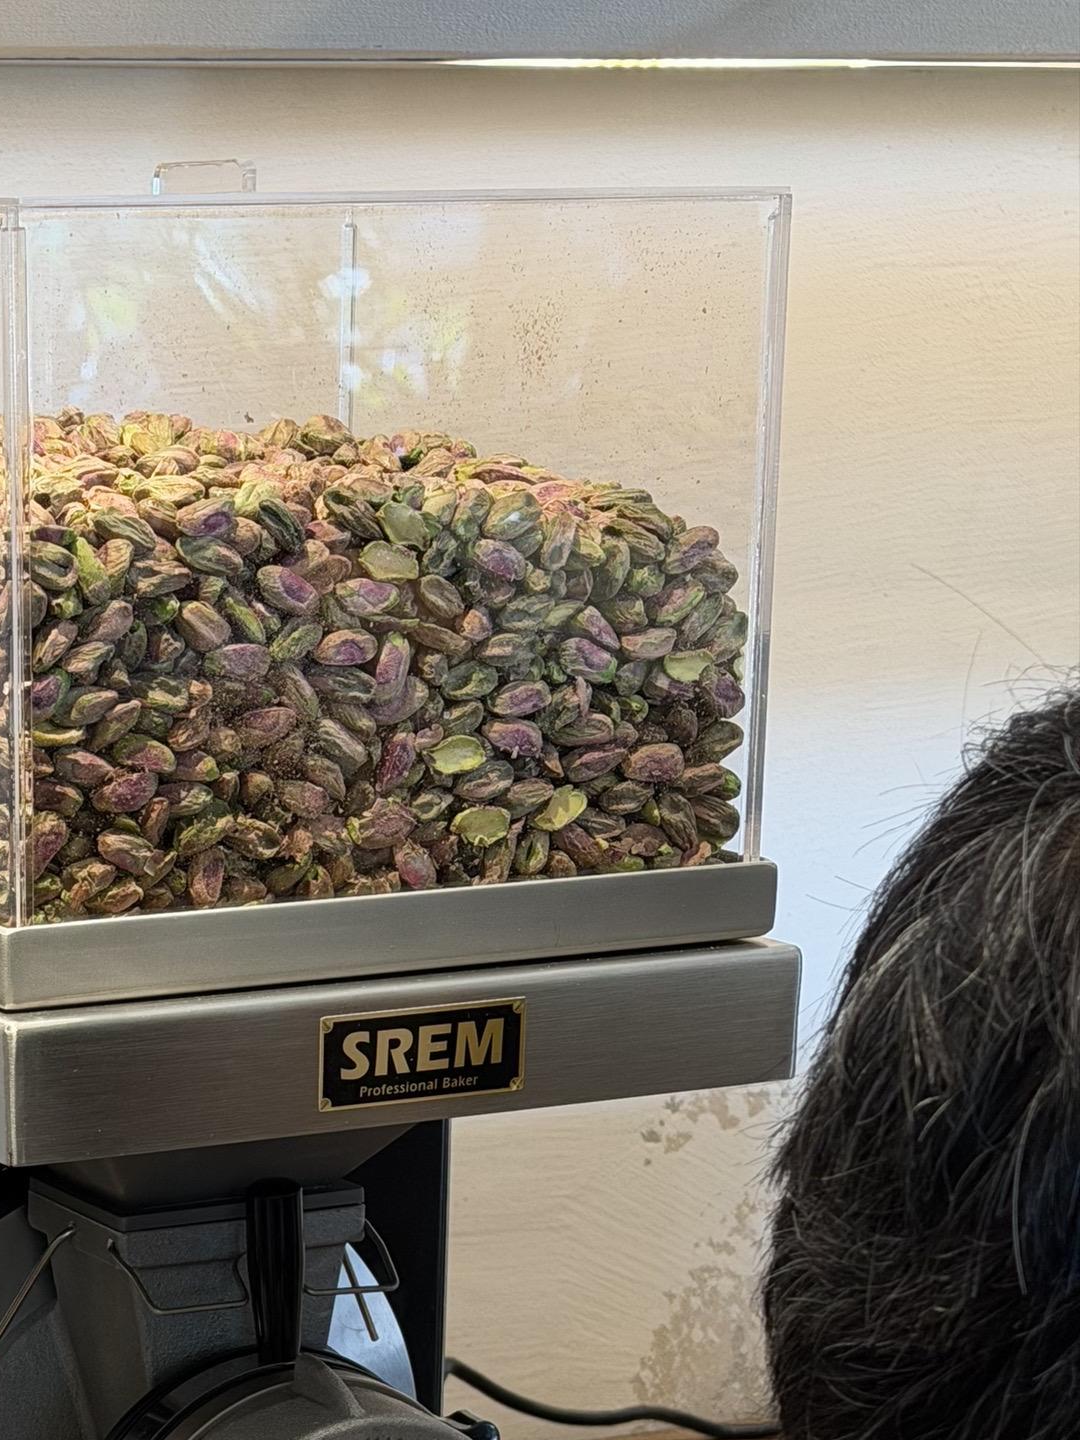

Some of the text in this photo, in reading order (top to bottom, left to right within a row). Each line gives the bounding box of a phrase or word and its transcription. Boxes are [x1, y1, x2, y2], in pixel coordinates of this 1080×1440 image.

[340, 1018, 505, 1081] SREM
[359, 1075, 479, 1098] Professional Baker
